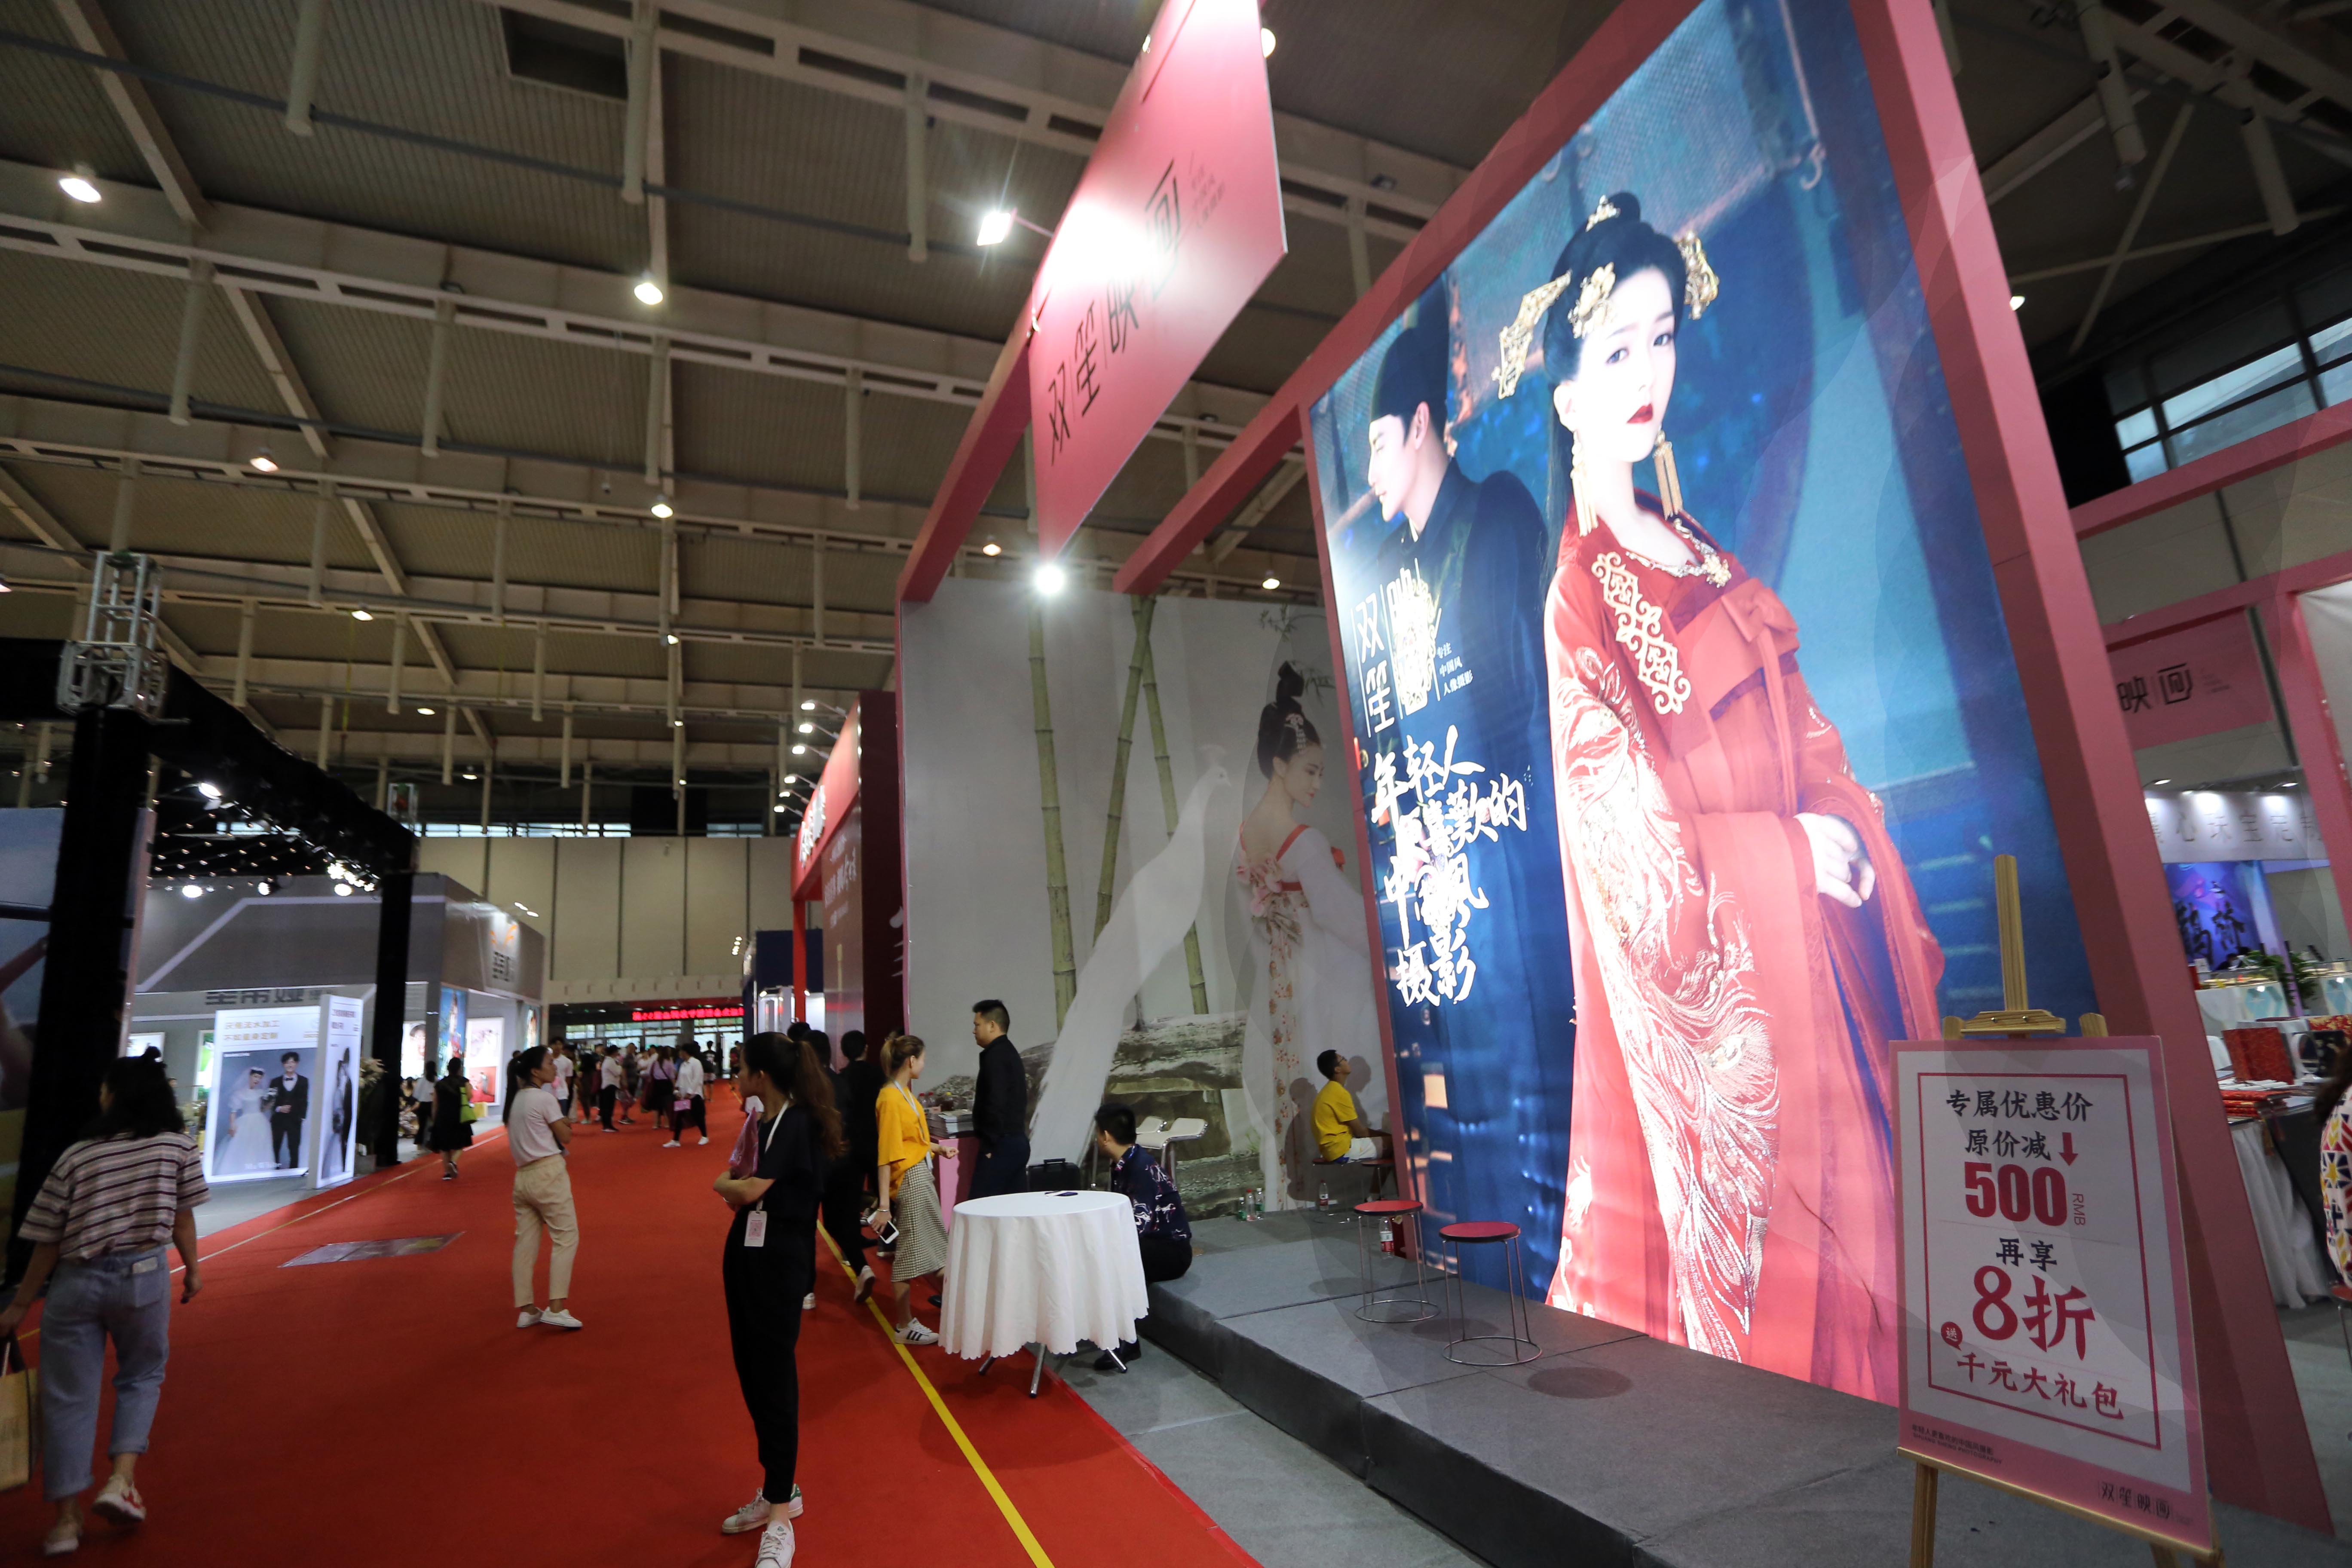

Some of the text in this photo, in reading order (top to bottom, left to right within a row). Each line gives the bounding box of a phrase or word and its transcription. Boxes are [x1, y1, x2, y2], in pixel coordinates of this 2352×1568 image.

[1439, 656, 1463, 677] 中国风
[1396, 927, 1477, 1007] 摄影
[1946, 1089, 2094, 1122] 专属优惠价
[1965, 1129, 2052, 1161] 原价减
[1964, 1161, 2067, 1226] 500
[2072, 1193, 2086, 1226] RMB
[1996, 1237, 2058, 1272] 再享
[1972, 1265, 2096, 1361] 8折
[1946, 1327, 1959, 1342] 送
[1957, 1351, 2124, 1419] 千元大礼包
